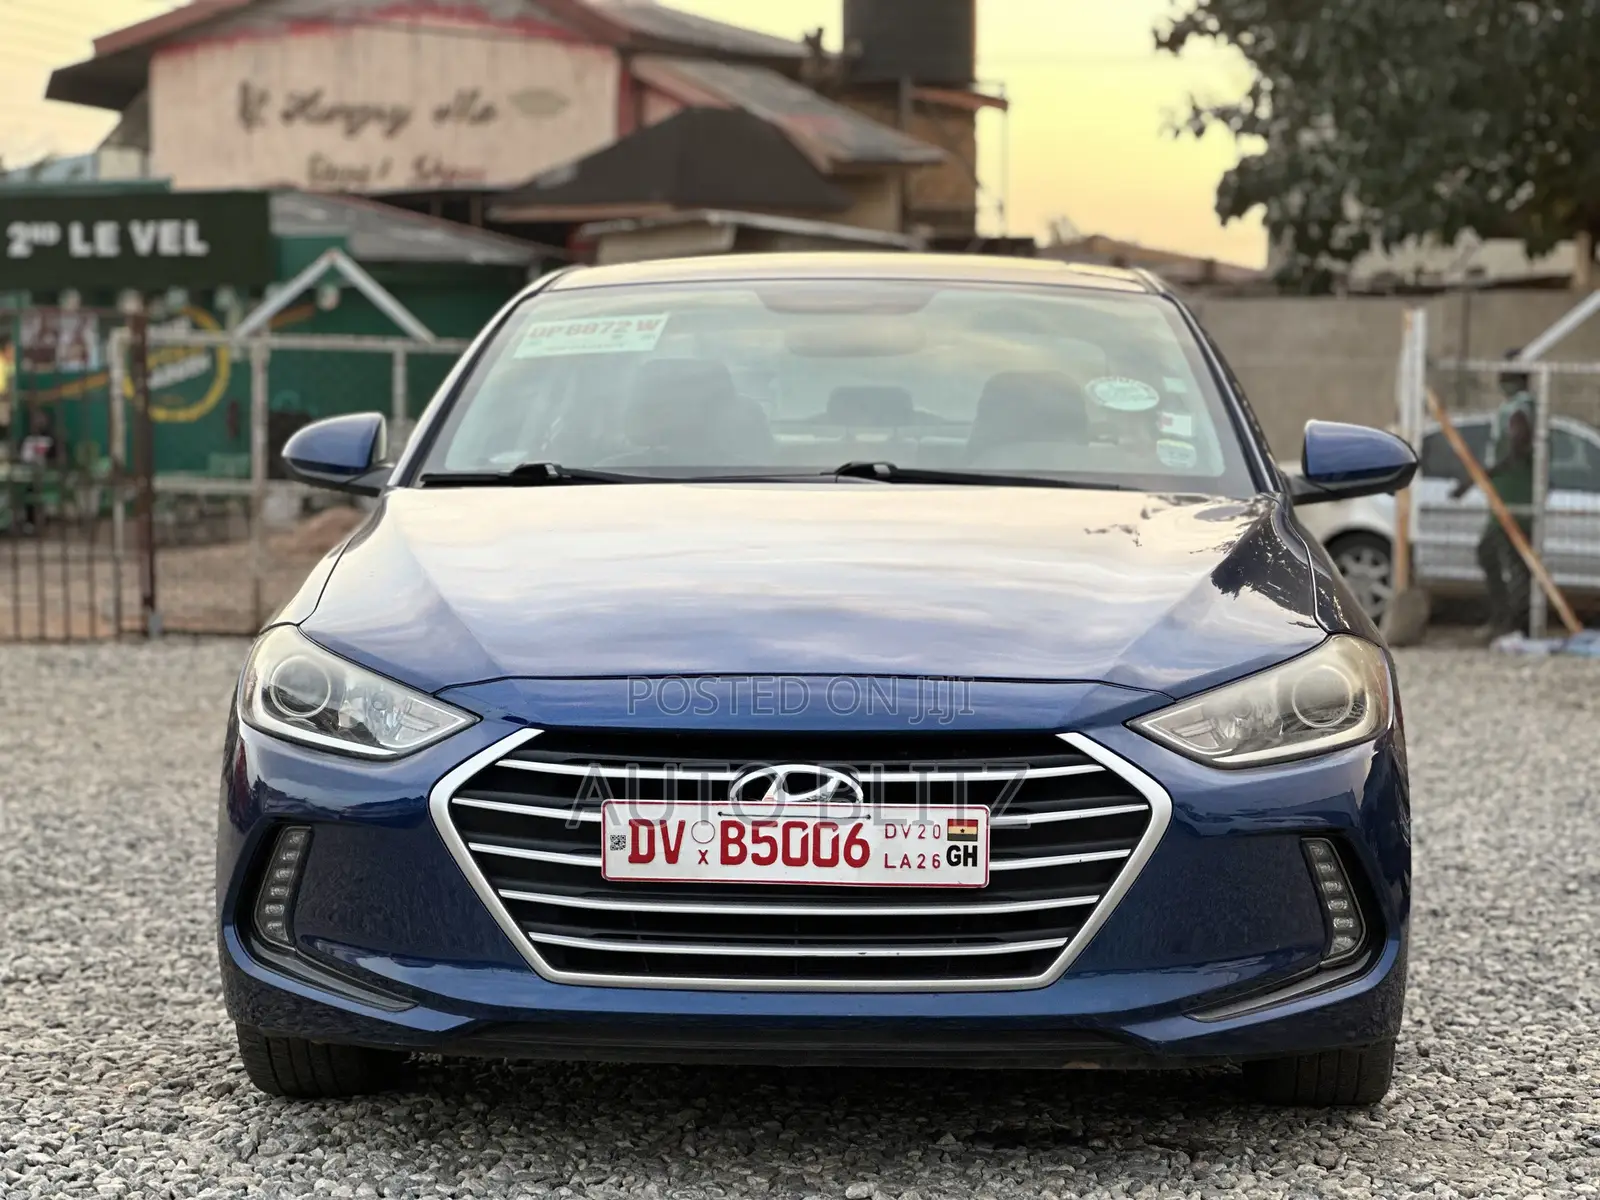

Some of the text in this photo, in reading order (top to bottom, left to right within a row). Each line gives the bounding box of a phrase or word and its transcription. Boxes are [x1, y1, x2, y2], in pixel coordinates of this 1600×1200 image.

[884, 823, 942, 840] DV20
[627, 818, 686, 865] DV
[719, 818, 871, 869] B5006
[884, 852, 942, 869] LA26
[946, 844, 978, 868] GH
